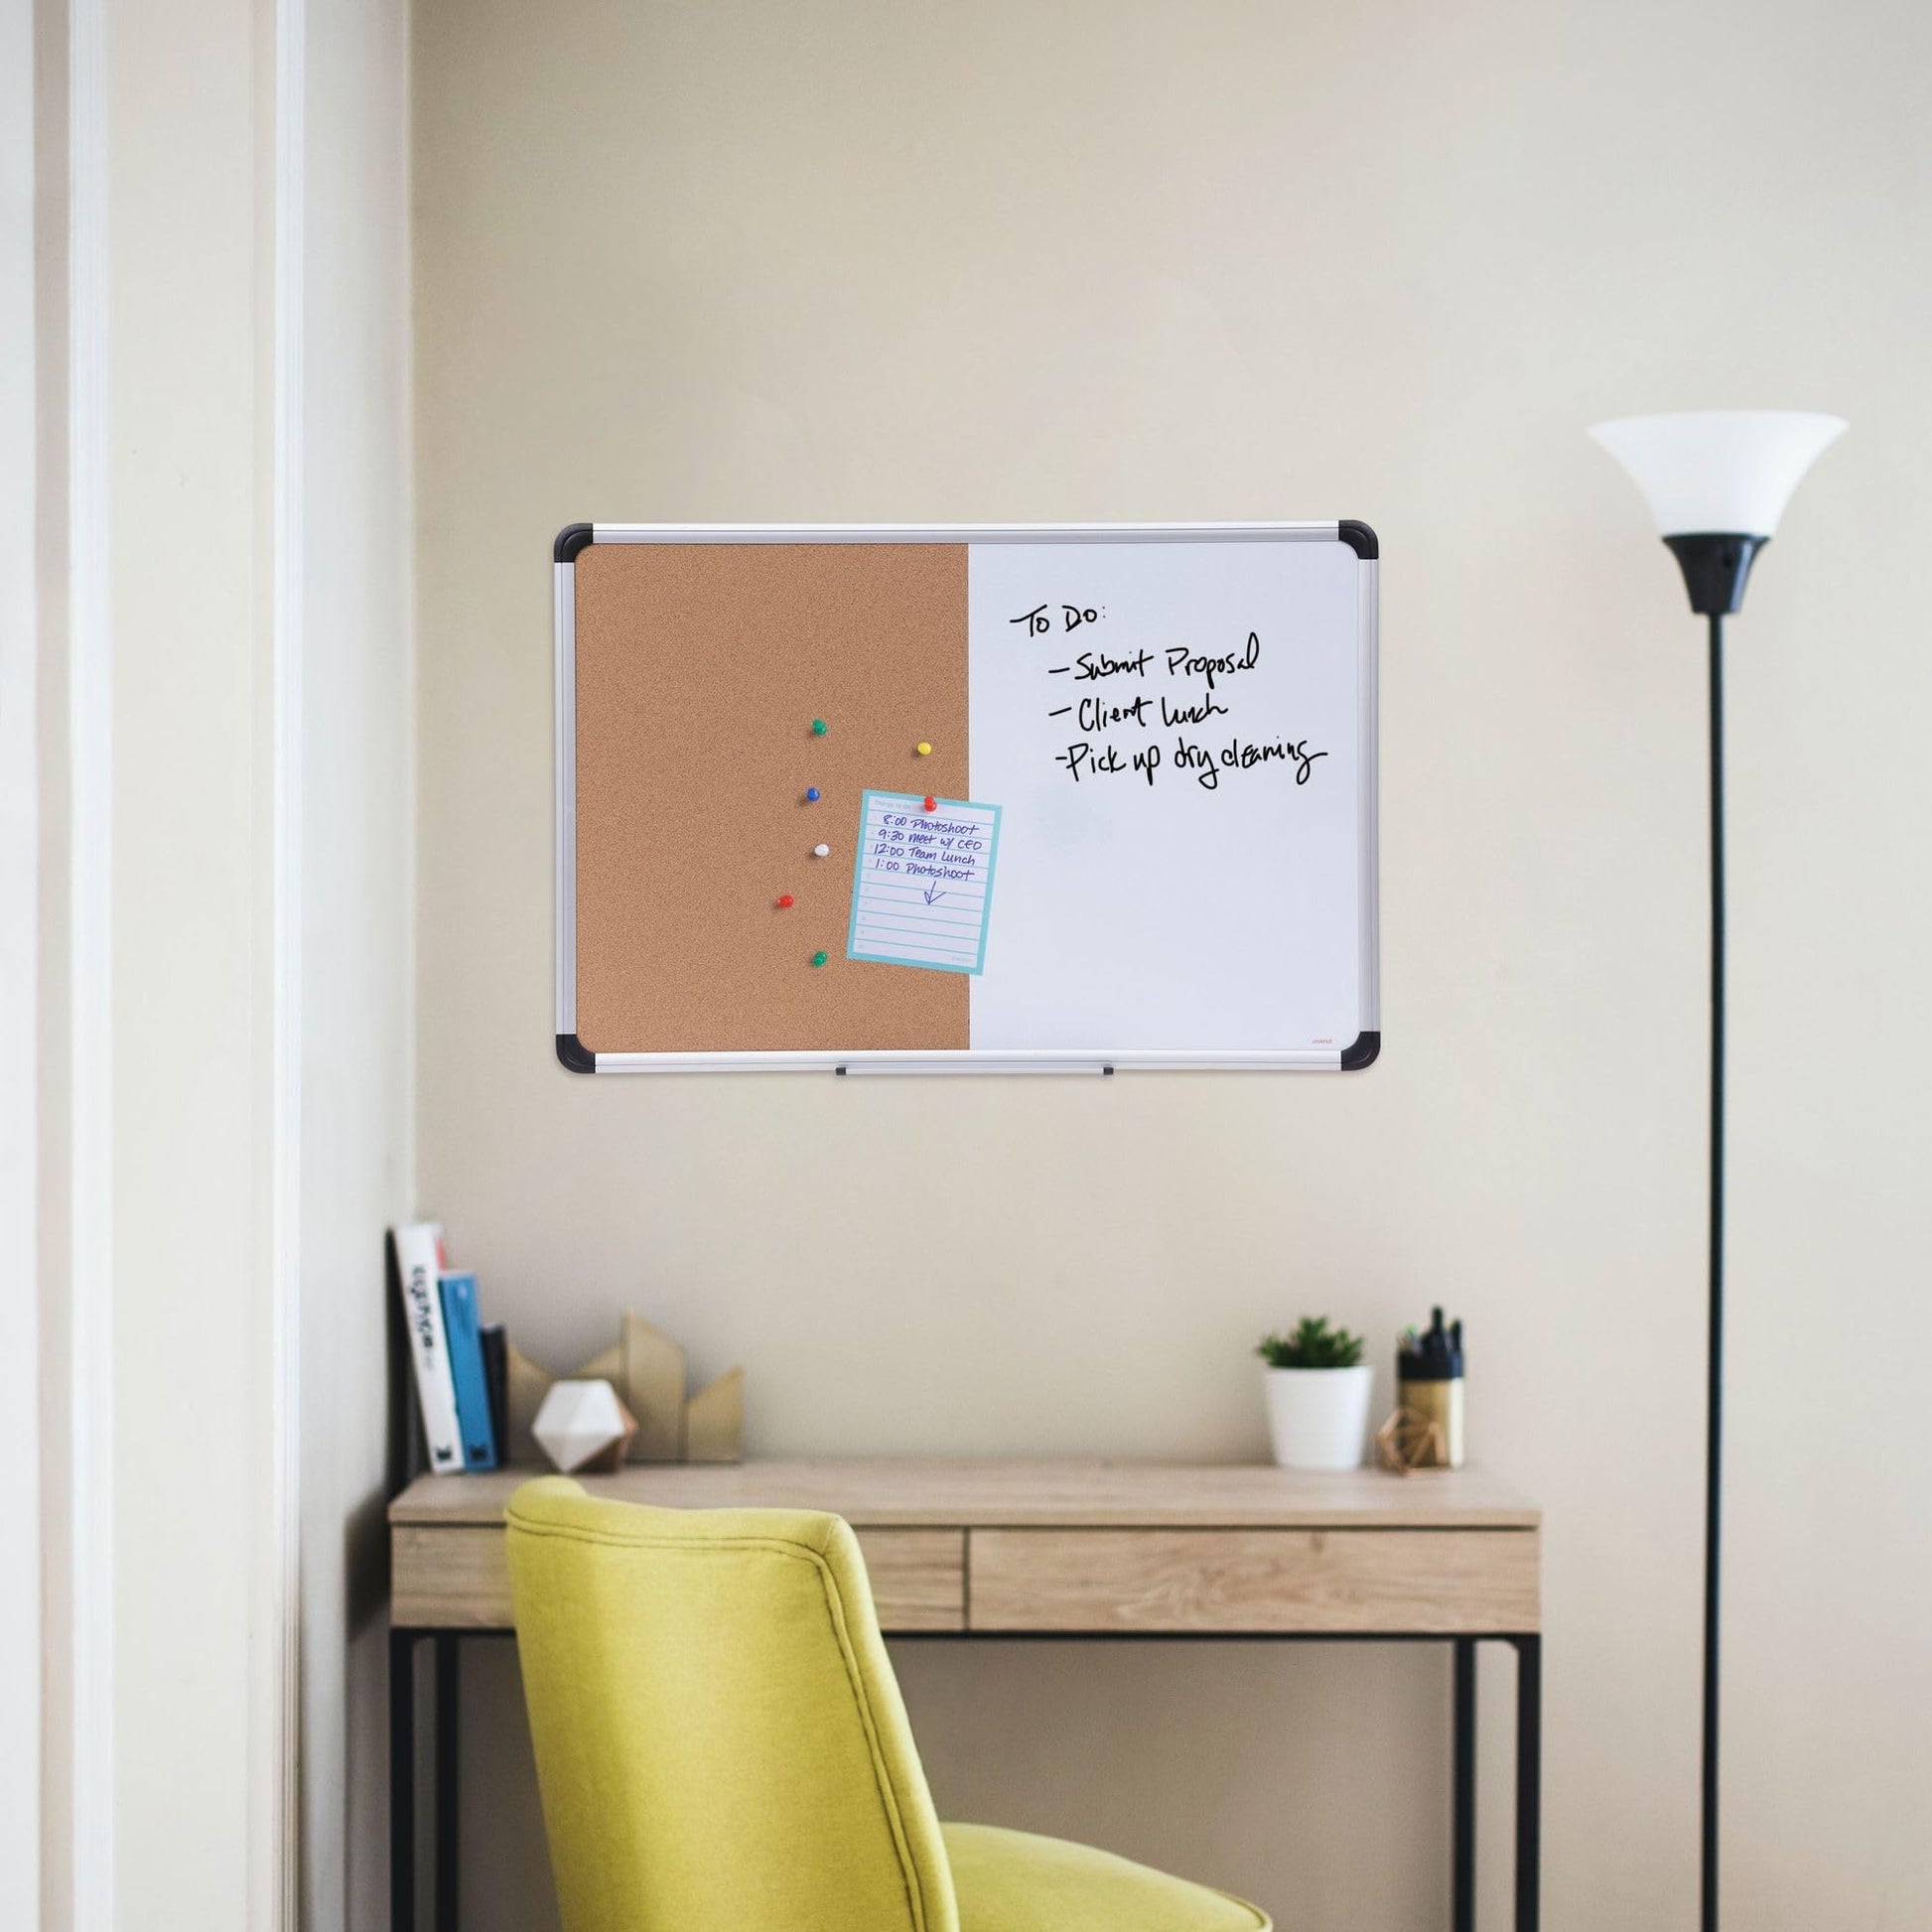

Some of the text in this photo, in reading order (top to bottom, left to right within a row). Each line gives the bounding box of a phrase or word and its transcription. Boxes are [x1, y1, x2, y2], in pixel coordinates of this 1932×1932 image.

[1010, 605, 1105, 637] To Do:
[1166, 632, 1259, 689] Proposal
[1134, 746, 1161, 786] up
[1174, 737, 1219, 789] dry
[883, 814, 907, 826] 8:00
[910, 818, 980, 835] Photoshoot
[878, 828, 904, 841] 9:30
[940, 837, 954, 849] w/
[957, 839, 983, 851] CEO
[874, 843, 904, 857] 12:00
[908, 847, 937, 860] Team
[875, 858, 900, 872] 1:00
[905, 863, 975, 881] Photoshoot
